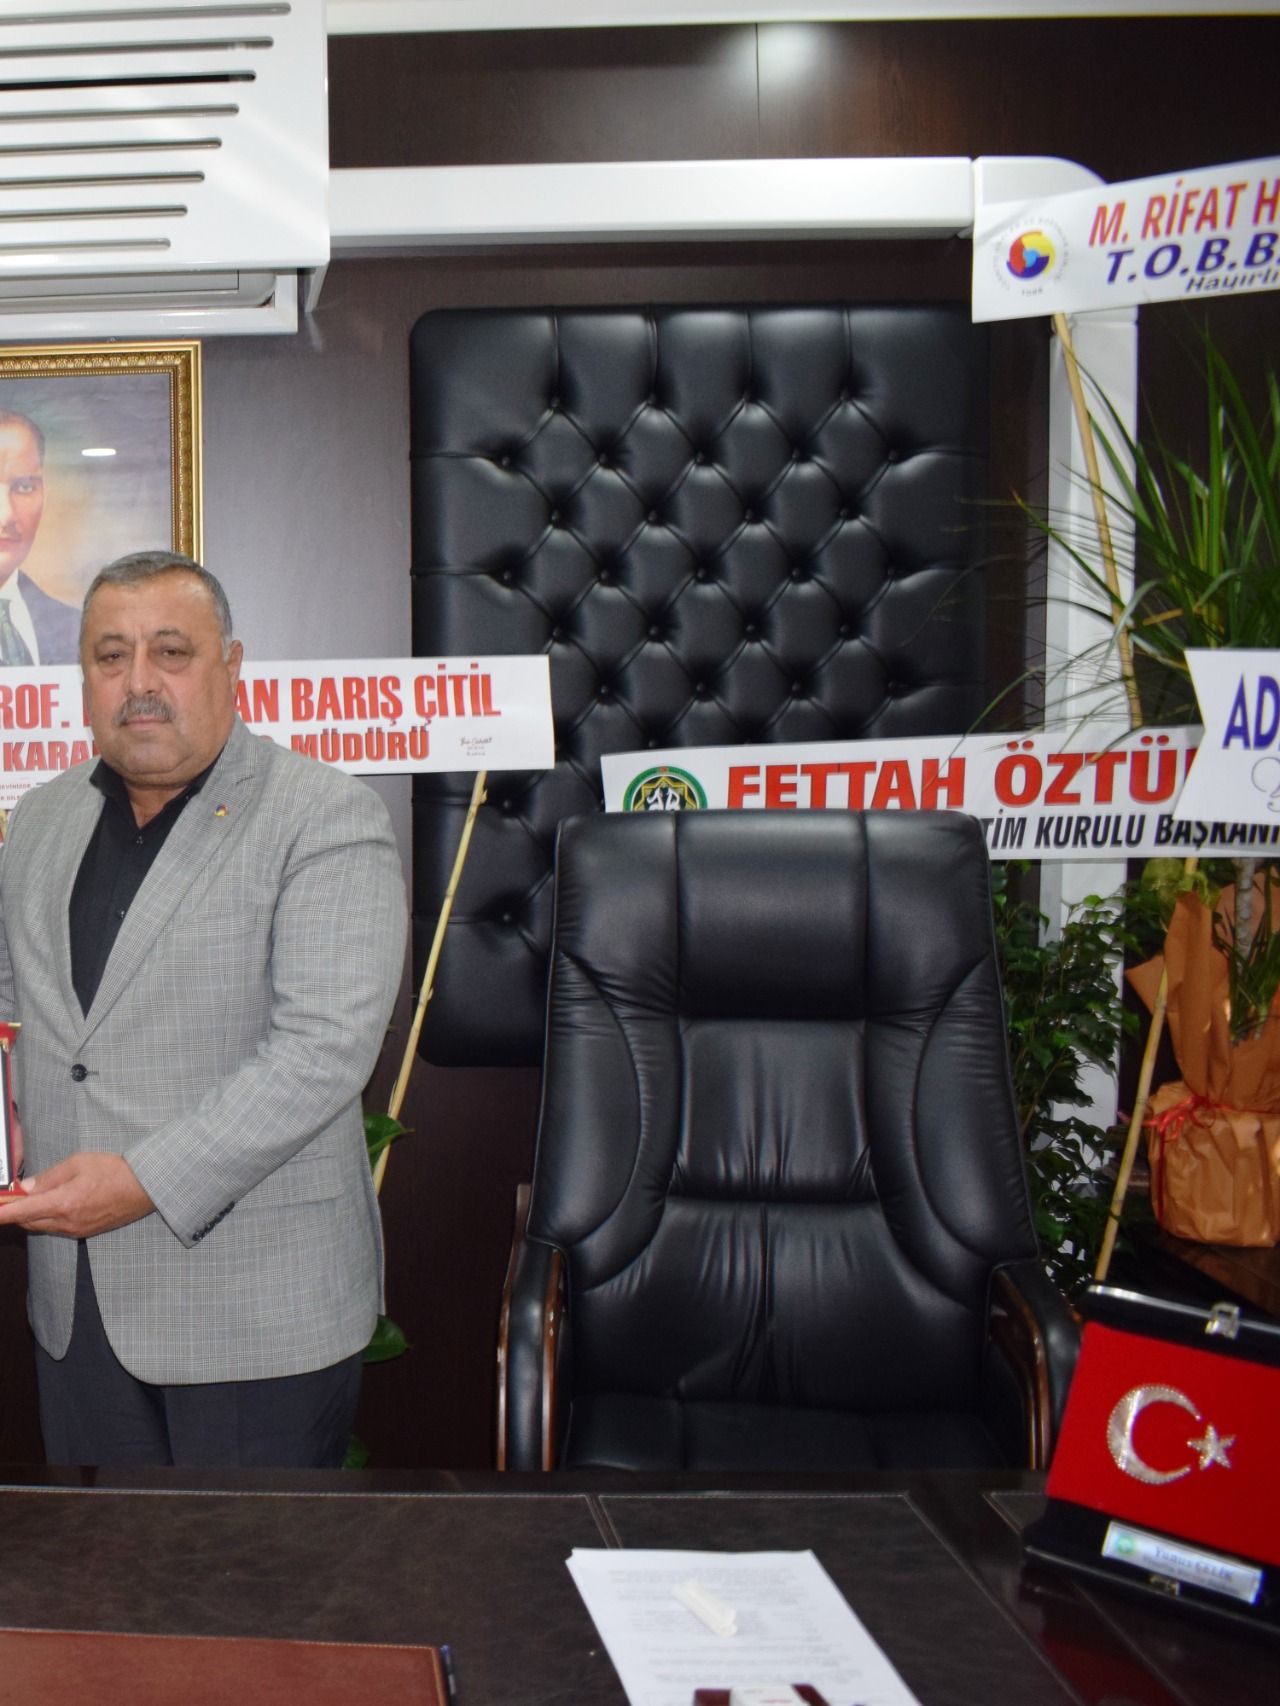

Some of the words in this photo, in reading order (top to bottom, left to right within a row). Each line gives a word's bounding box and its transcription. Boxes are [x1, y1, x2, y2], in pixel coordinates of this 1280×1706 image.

[1089, 202, 1128, 248] M.
[1140, 179, 1248, 241] RİFAT
[234, 678, 279, 724] AN
[291, 675, 403, 726] BARIŞ
[414, 663, 501, 725] ÇİTİL
[1222, 672, 1280, 750] AD
[3, 740, 101, 772] KARA
[291, 725, 431, 763] MÜDÜRÜ
[727, 757, 967, 812] FETTAH
[980, 808, 1028, 850] TİM
[1034, 814, 1146, 849] KURULU
